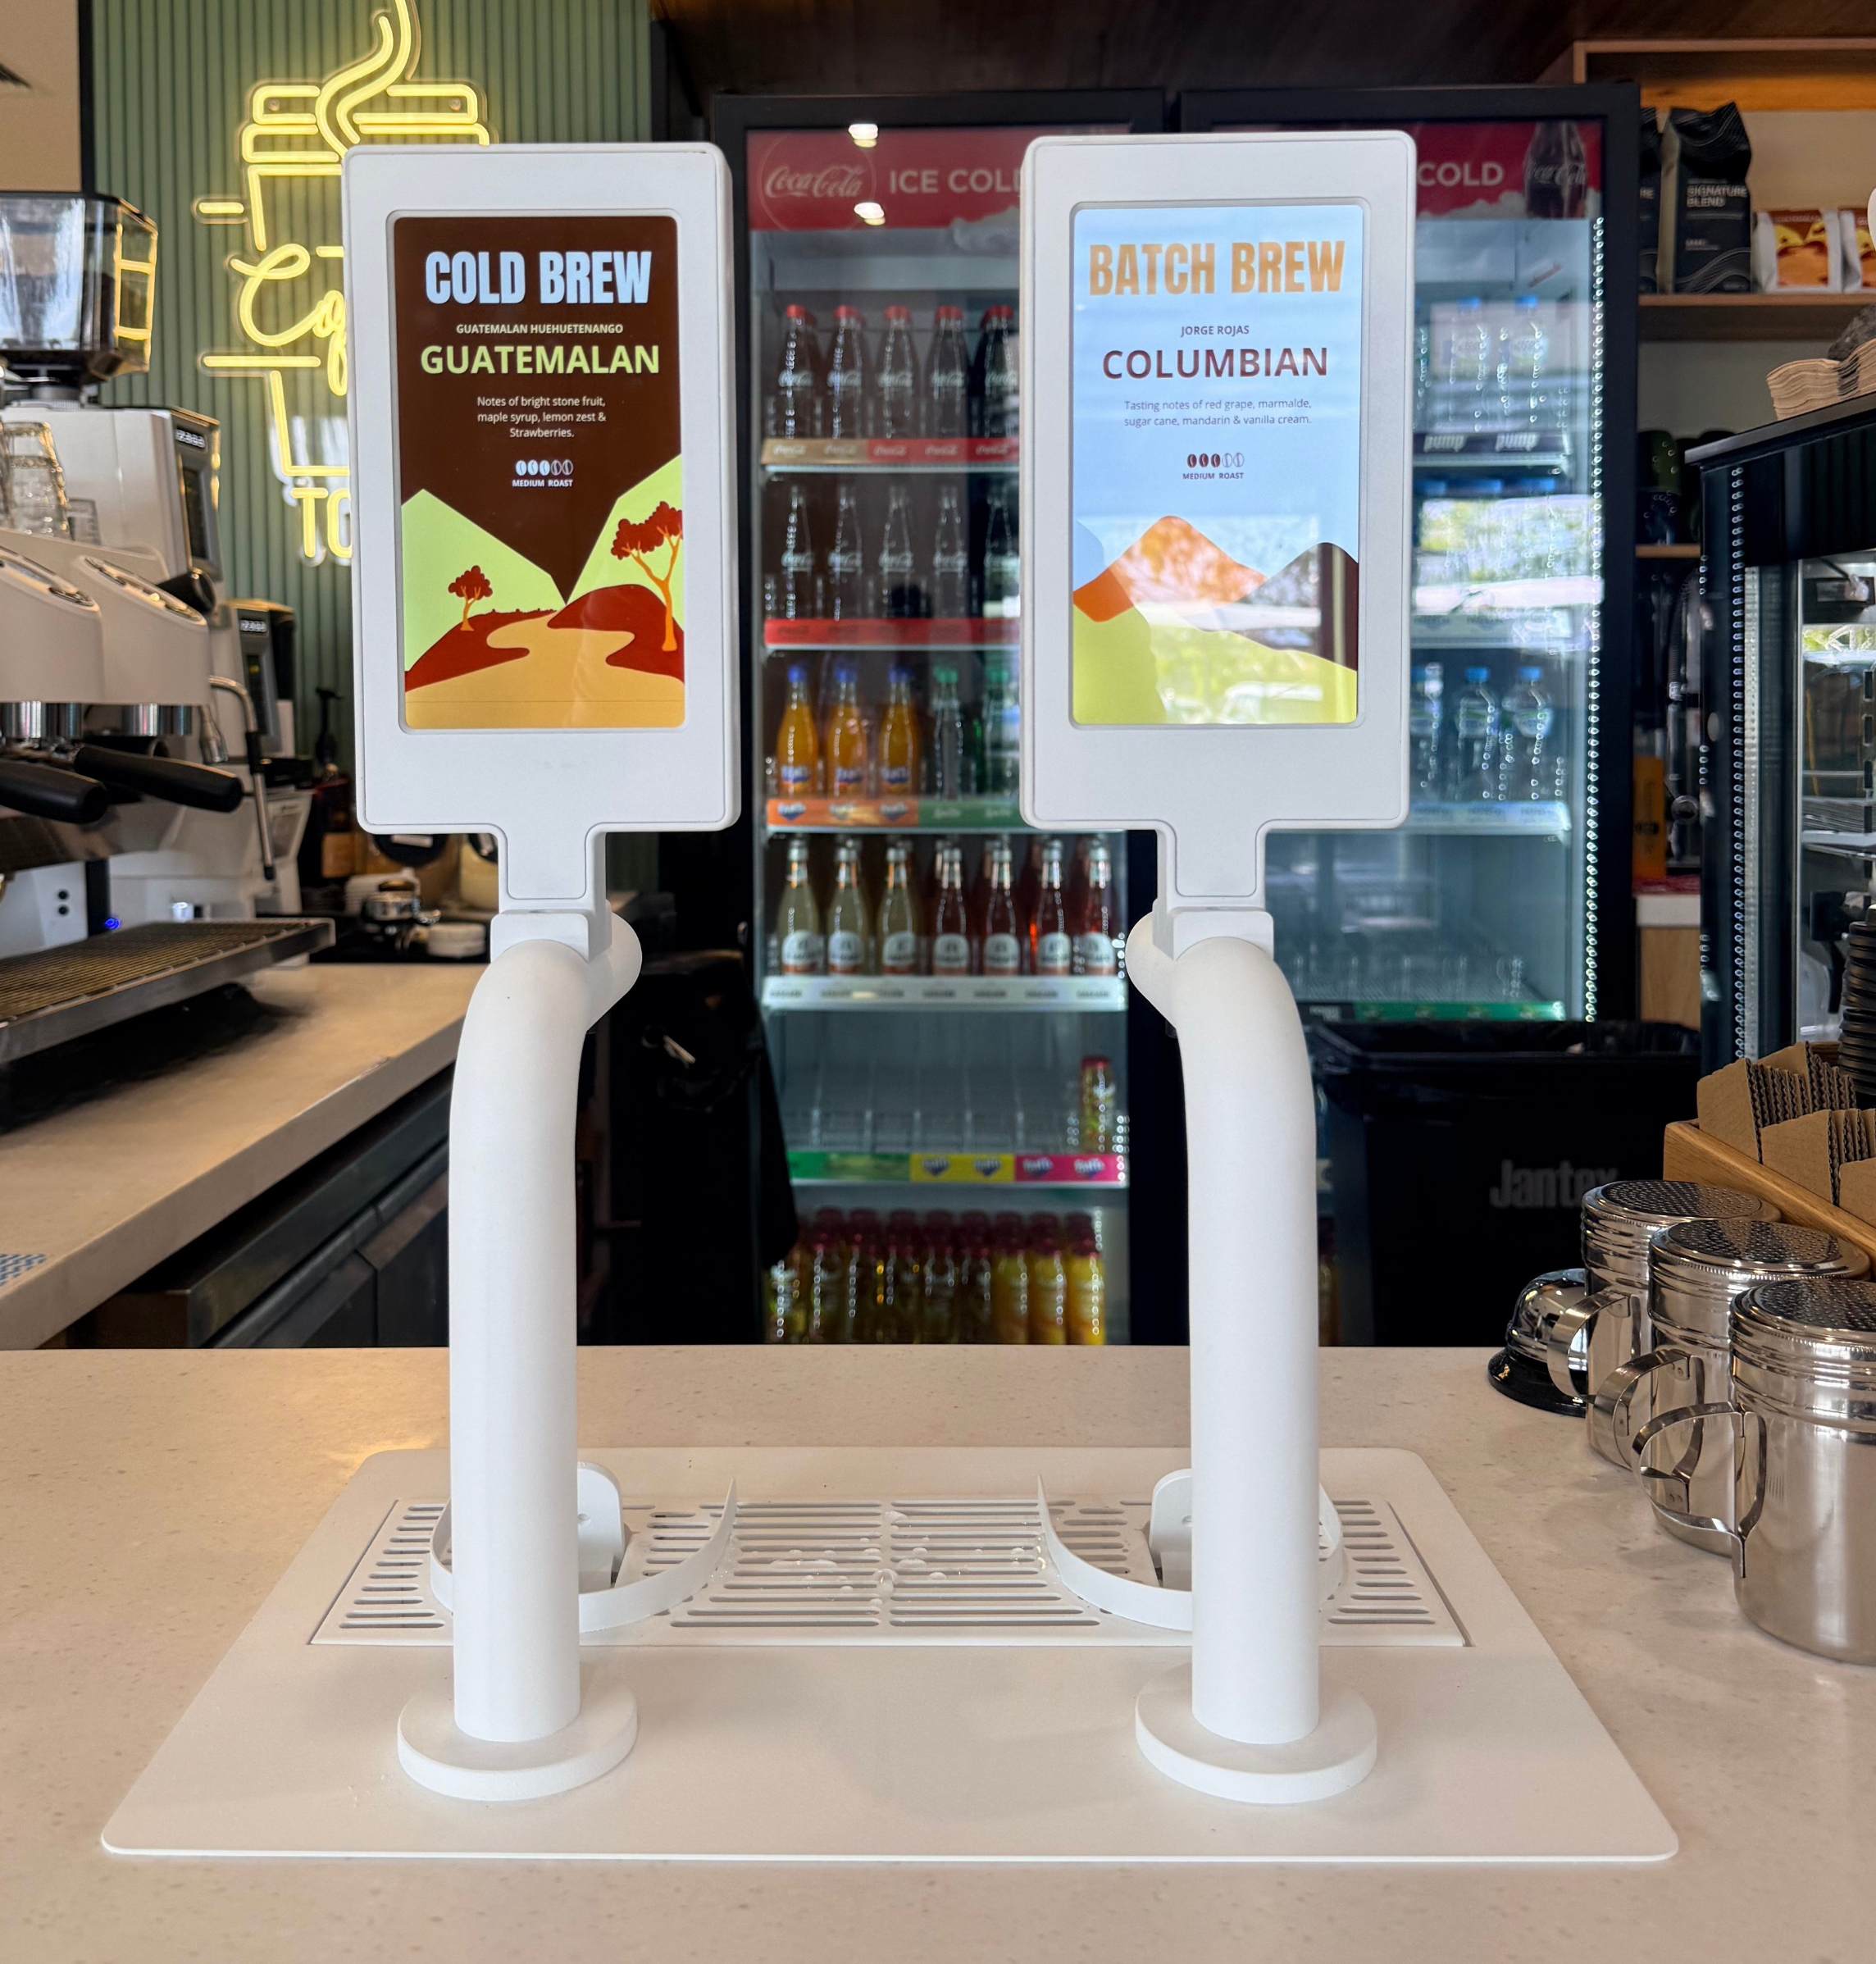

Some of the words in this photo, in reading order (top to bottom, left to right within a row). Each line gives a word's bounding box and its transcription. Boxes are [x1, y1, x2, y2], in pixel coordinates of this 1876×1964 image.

[890, 168, 938, 194] ICE
[1417, 162, 1504, 187] COLD
[1687, 185, 1748, 198] SIGNATURE
[1686, 196, 1726, 208] BLEND
[1089, 243, 1215, 296] BATCH
[1231, 240, 1346, 294] BREW
[425, 250, 526, 304] COLD
[539, 250, 653, 304] BREW
[456, 324, 528, 335] GUATEMALAN
[530, 324, 624, 335] HUEHUETENANGO
[1180, 326, 1214, 338] JORGE
[1217, 325, 1250, 338] ROJAS
[421, 344, 659, 375] GUATEMALAN
[1103, 347, 1327, 380] COLUMBIAN
[476, 396, 507, 407] Notes
[508, 395, 520, 407] of
[521, 395, 551, 409] bright
[552, 398, 581, 407] stone
[581, 395, 606, 408] fruit,
[1123, 400, 1160, 412] Tasting
[1162, 401, 1191, 411] notes
[1192, 399, 1204, 410] of
[1204, 399, 1223, 410] red
[1223, 400, 1255, 412] grape,
[1258, 399, 1312, 410] marmalde,
[477, 412, 508, 425] maple
[510, 413, 541, 425] syrup,
[542, 411, 574, 422] lemon
[576, 412, 596, 422] zest
[598, 412, 607, 422] &
[1123, 417, 1152, 429] sugar
[1154, 417, 1180, 427] cane,
[1182, 415, 1231, 426] mandarin
[1232, 416, 1241, 426] &
[1243, 415, 1275, 426] vanilla
[1277, 416, 1312, 425] cream.
[509, 427, 575, 438] Strawberries.
[1218, 472, 1245, 480] ROAST
[512, 480, 545, 488] MEDIUM
[548, 480, 574, 488] ROAST
